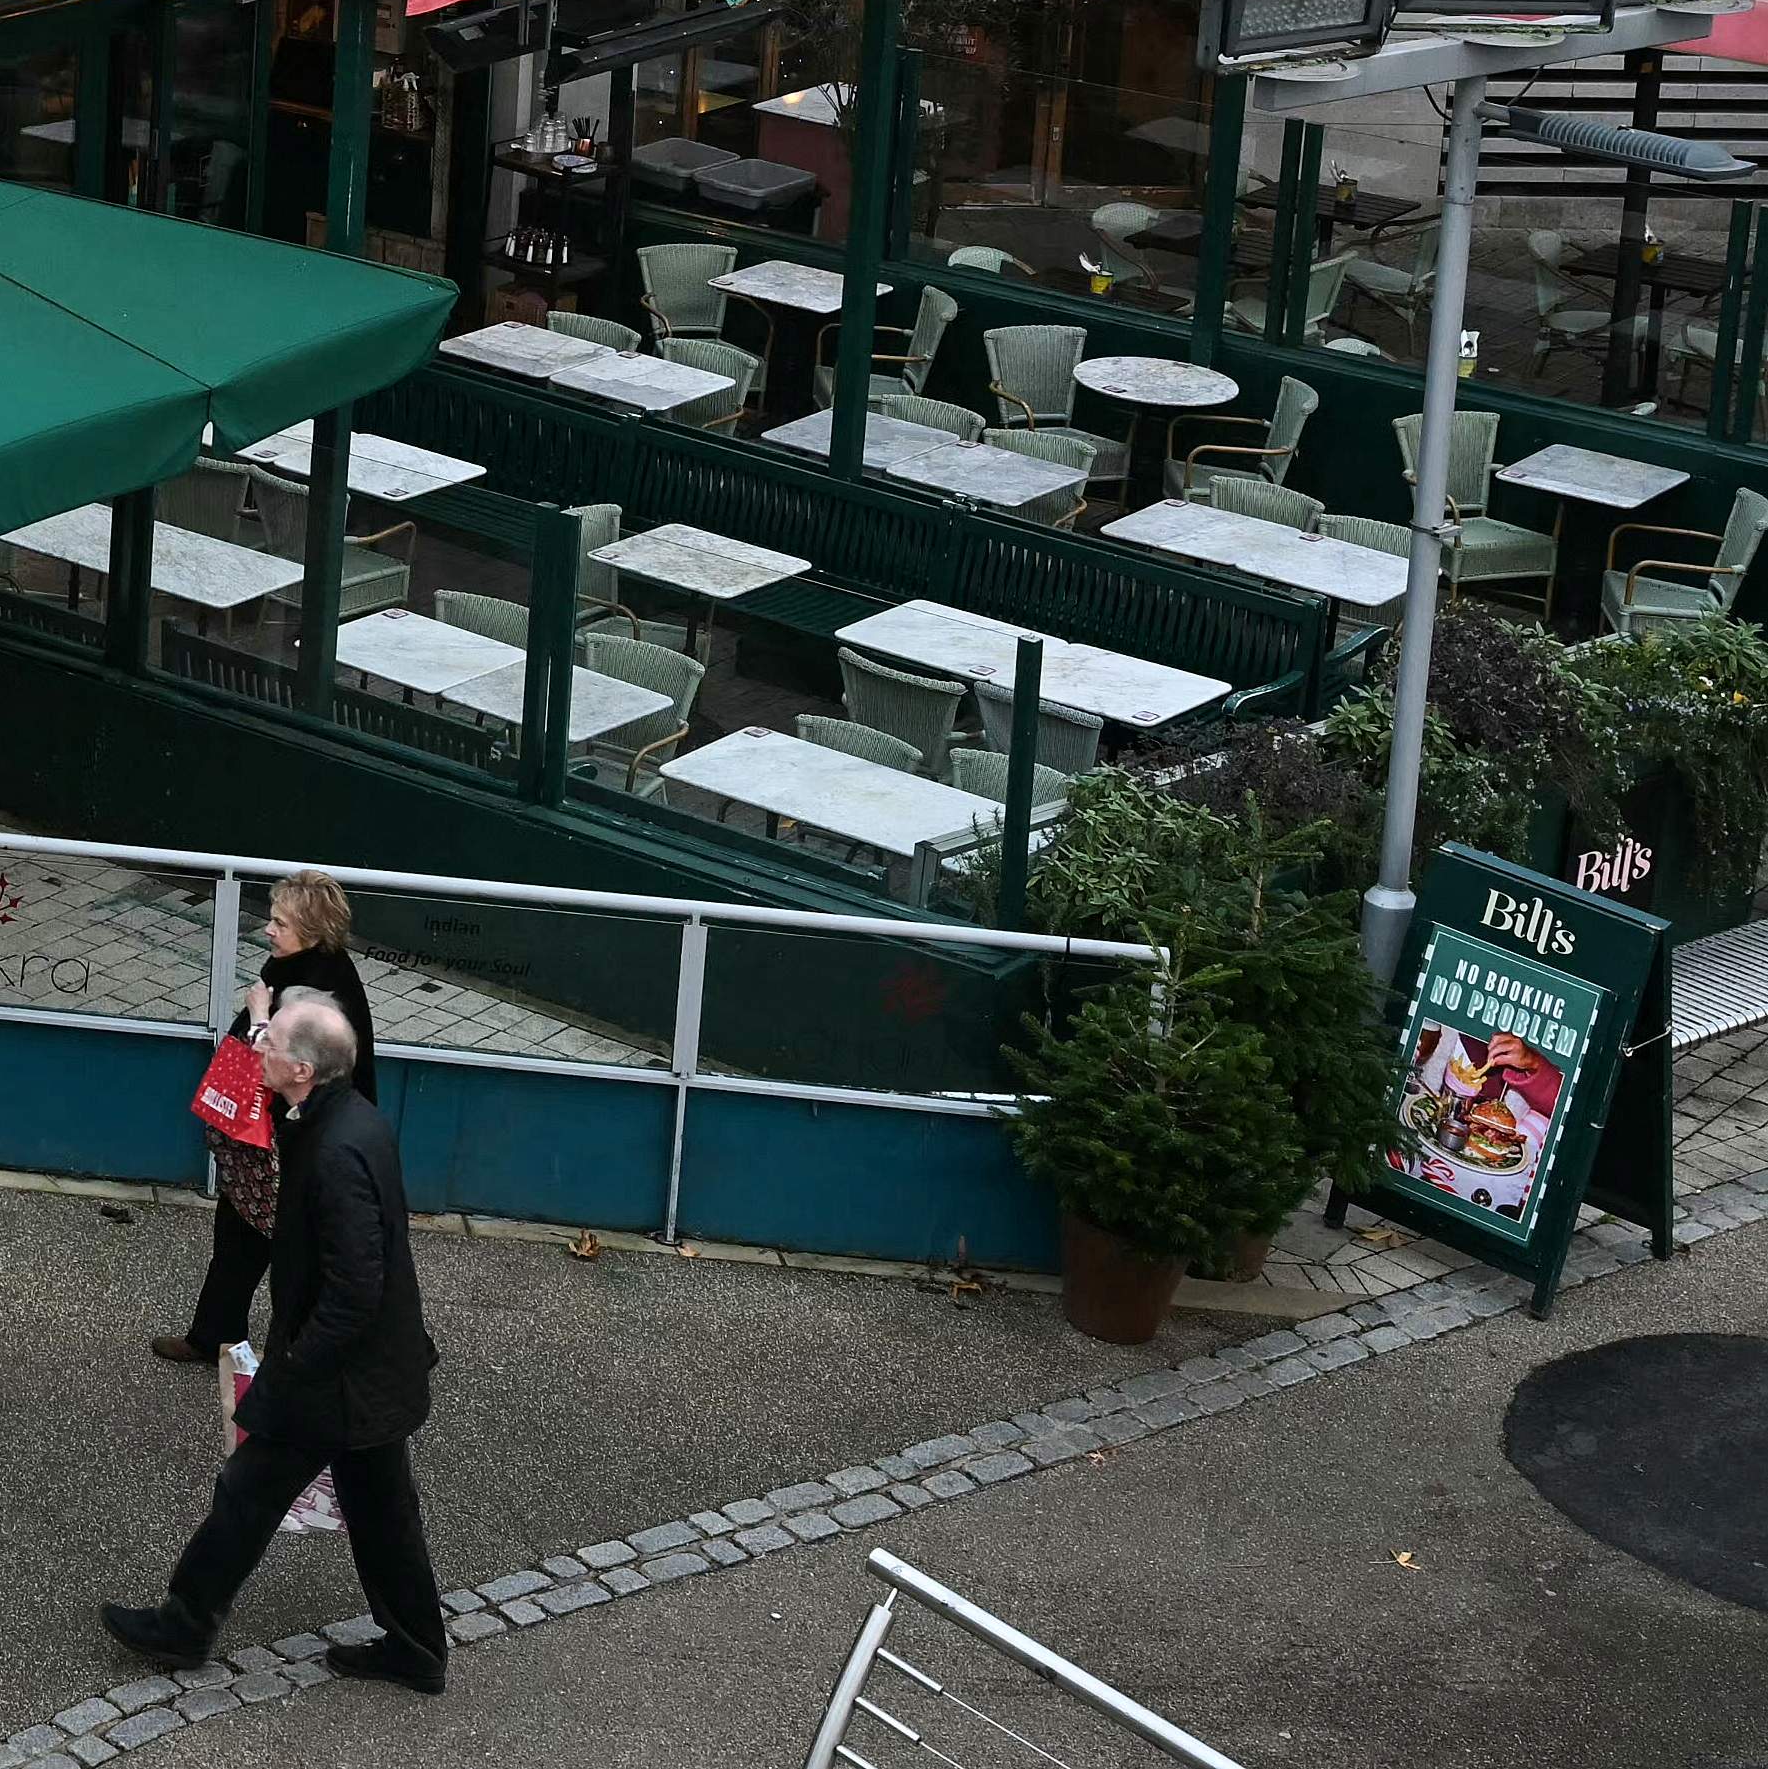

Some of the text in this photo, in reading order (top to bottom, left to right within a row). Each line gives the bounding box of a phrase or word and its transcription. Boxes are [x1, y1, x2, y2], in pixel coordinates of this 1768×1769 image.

[1576, 833, 1653, 893] Bill's
[424, 915, 481, 936] Indian
[1479, 887, 1576, 955] Bill's
[364, 945, 532, 977] Food for your Soul
[1455, 959, 1566, 1020] NO BOOKING
[1429, 974, 1578, 1058] NO PROBLEM
